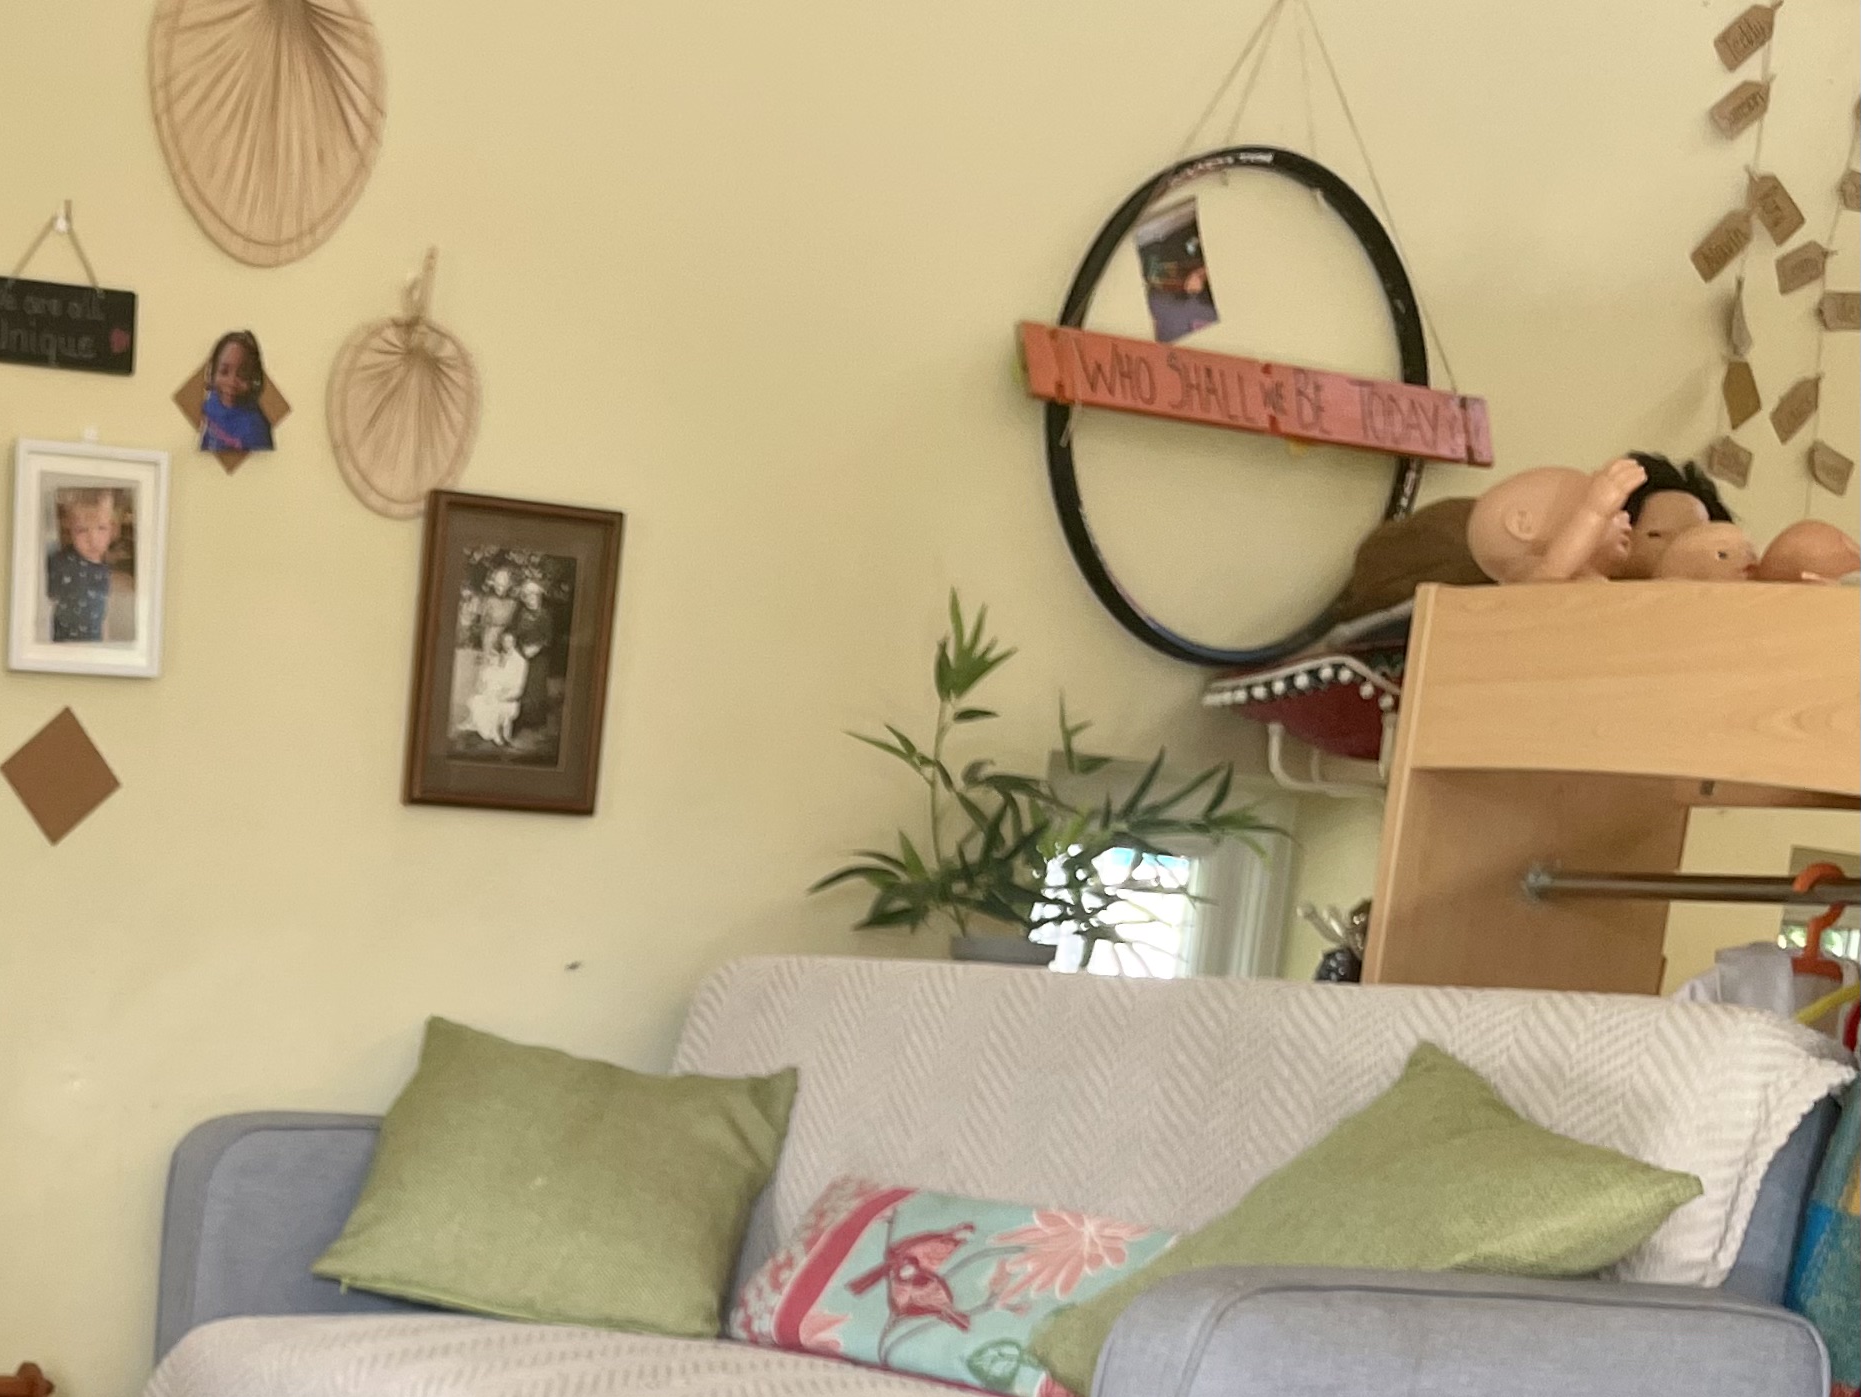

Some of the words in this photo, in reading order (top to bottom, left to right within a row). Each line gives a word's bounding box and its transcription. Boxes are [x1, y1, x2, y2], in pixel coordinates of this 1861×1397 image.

[23, 295, 63, 318] are
[1072, 337, 1158, 406] WHO
[1167, 352, 1258, 424] SHALL
[1293, 367, 1333, 436] BE
